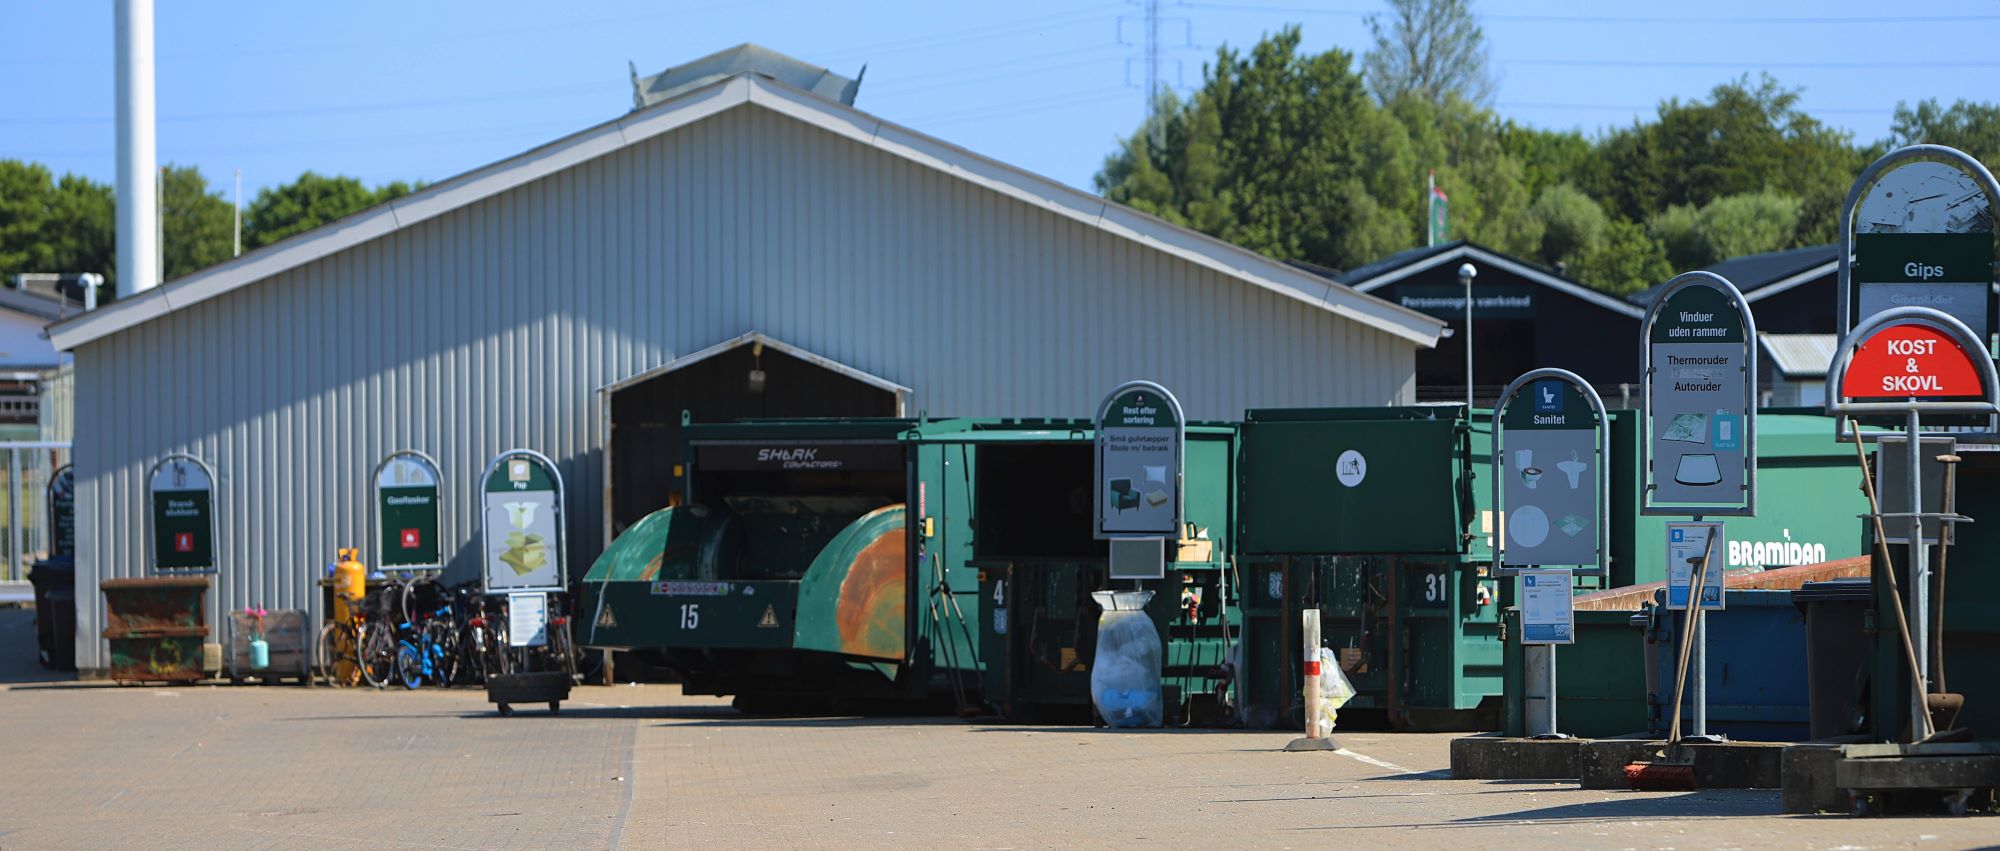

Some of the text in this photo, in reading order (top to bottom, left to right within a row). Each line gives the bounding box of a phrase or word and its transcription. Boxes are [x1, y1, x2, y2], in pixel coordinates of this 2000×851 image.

[1904, 262, 1944, 280] Gips
[1680, 311, 1713, 322] Vinduer
[1669, 326, 1728, 337] uden rammer
[1887, 339, 1937, 355] KOST
[1667, 355, 1729, 365] Thermoruder
[1905, 357, 1919, 373] &
[1674, 382, 1722, 392] Autoruder
[1882, 375, 1943, 391] SKOVL
[1123, 406, 1157, 415] Rest efter
[1123, 416, 1154, 425] sortering
[1533, 414, 1566, 425] Sanitet
[757, 448, 818, 461] SHARK
[1728, 529, 1826, 566] BRAMIDAN
[993, 579, 1004, 605] 4
[1425, 573, 1446, 602] 31
[680, 603, 699, 629] 15
